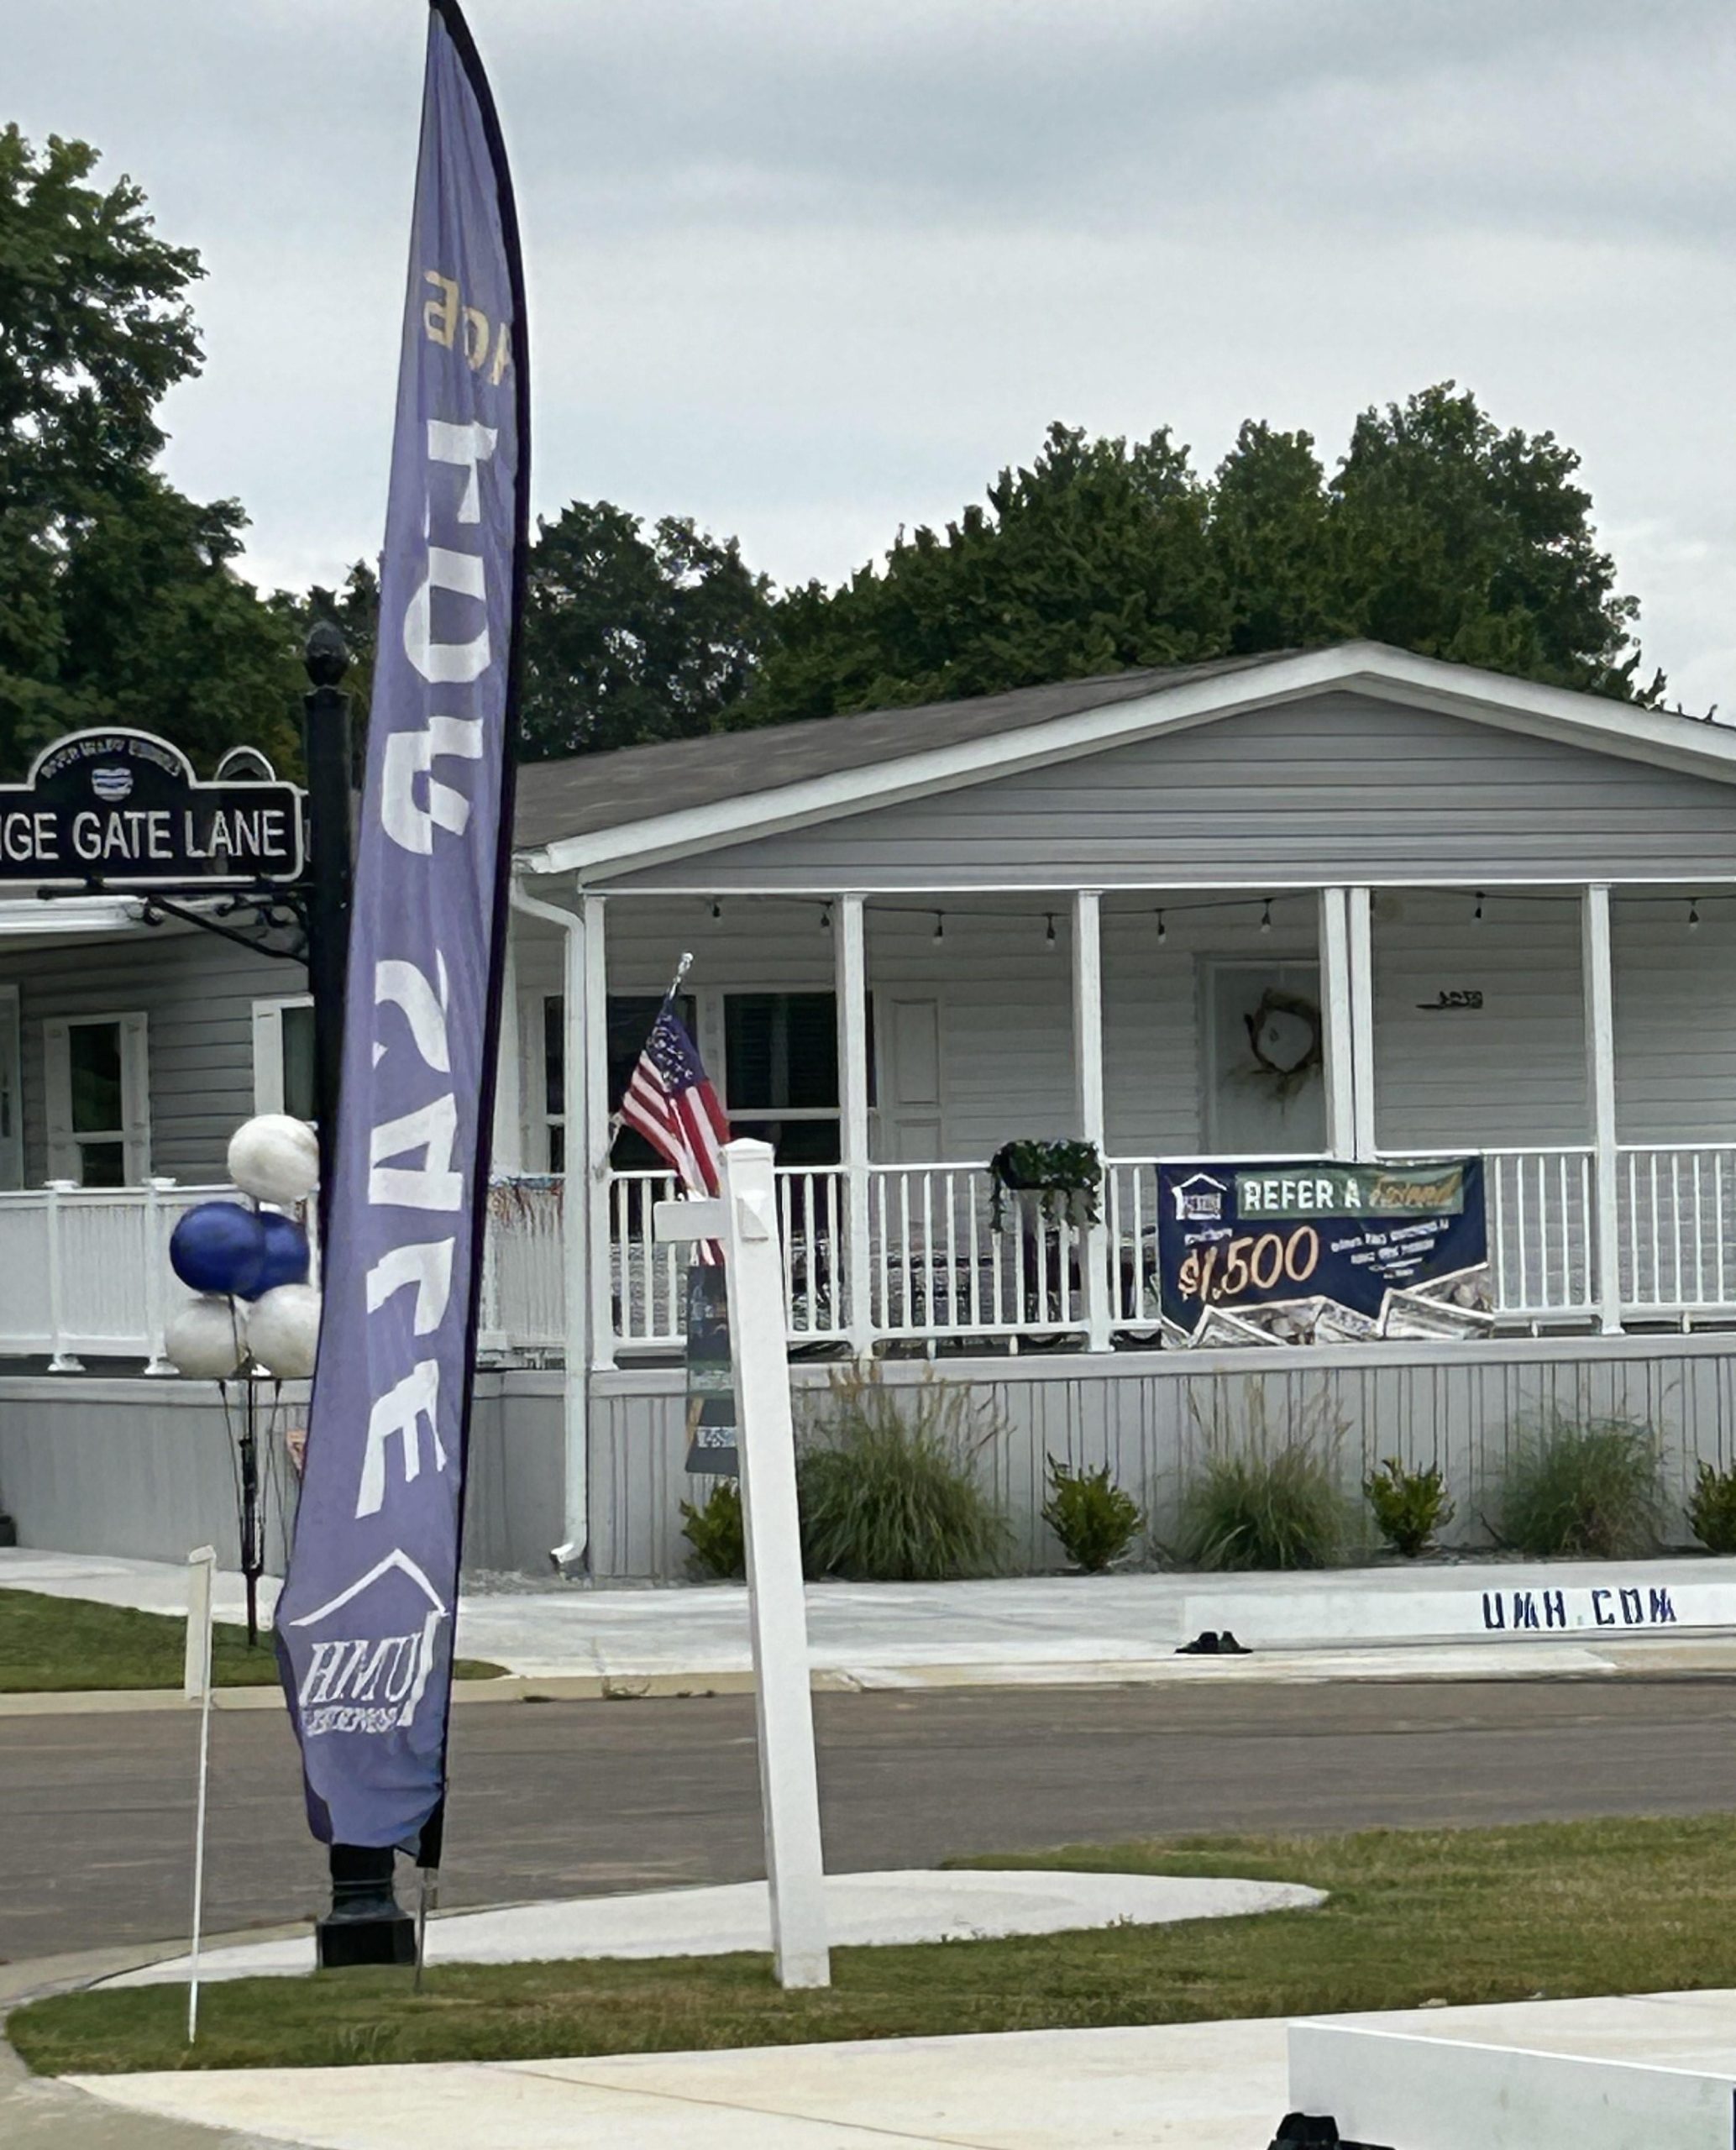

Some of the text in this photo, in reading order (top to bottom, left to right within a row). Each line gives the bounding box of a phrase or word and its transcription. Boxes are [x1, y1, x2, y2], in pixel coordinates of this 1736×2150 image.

[0, 810, 287, 861] GE GATE LANE
[1243, 1178, 1335, 1211] REFER
[1345, 1177, 1362, 1209] A
